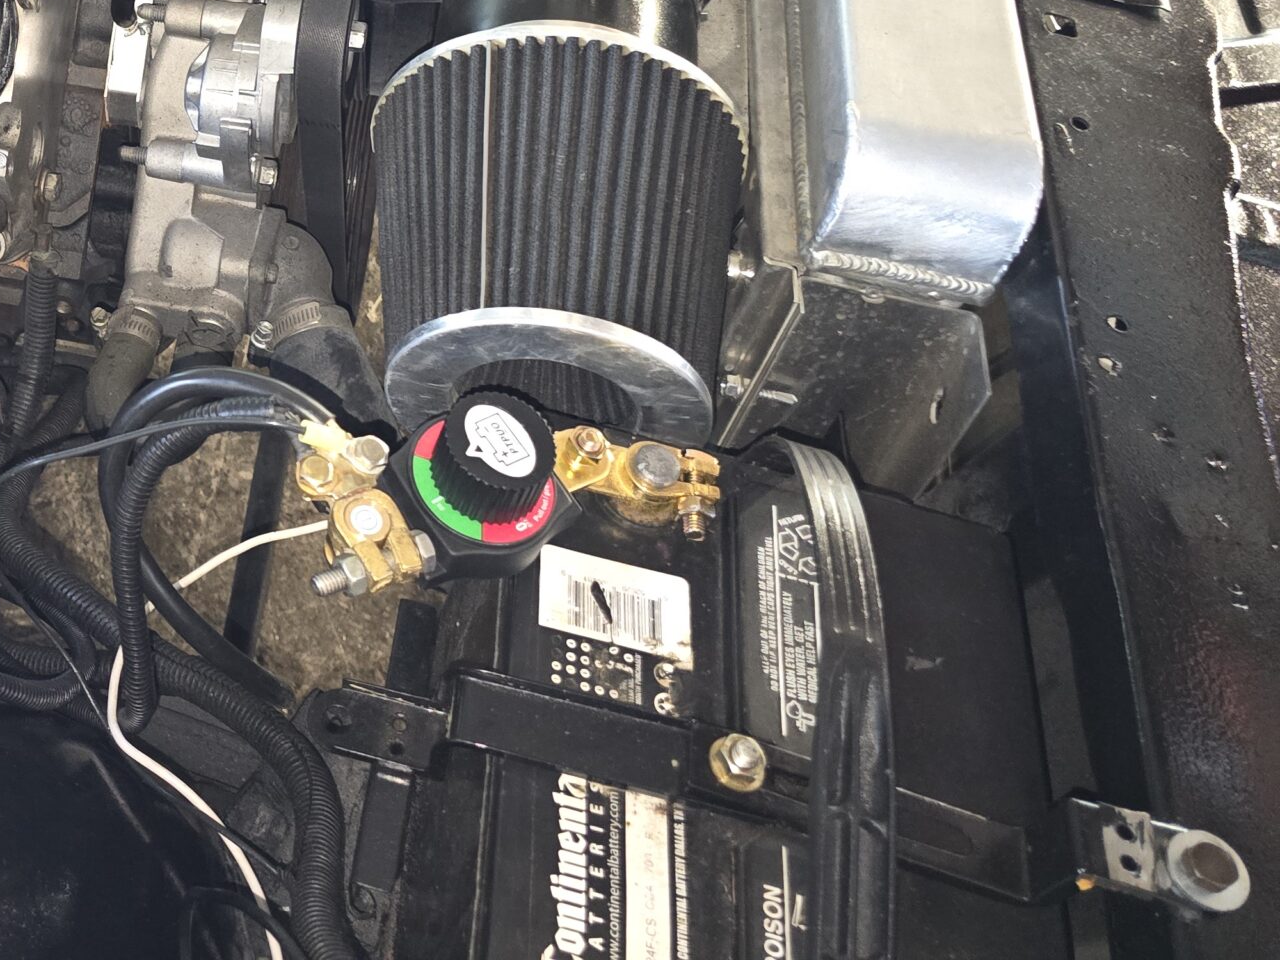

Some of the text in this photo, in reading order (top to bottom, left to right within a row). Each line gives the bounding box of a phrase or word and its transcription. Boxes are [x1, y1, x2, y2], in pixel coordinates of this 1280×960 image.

[764, 536, 773, 556] LEVEL
[765, 556, 774, 571] AND
[758, 580, 766, 590] OF
[766, 571, 774, 592] TIGHT
[759, 590, 767, 614] REACH
[766, 592, 775, 611] CAPS
[782, 590, 797, 699] FLUSH EYES IMMEDIATELY
[793, 625, 804, 643] GET
[760, 640, 769, 654] OUT
[769, 664, 778, 680] NOT
[804, 620, 818, 704] MEDICAL HELP FAST
[770, 680, 779, 692] DO
[796, 677, 808, 701] WITH
[541, 773, 588, 960] ontinenta
[588, 781, 605, 951] ATTERIES
[607, 790, 623, 960] ww.continentalbattery.com
[674, 856, 688, 897] BATTERY
[675, 897, 689, 960] CONTINENTAL
